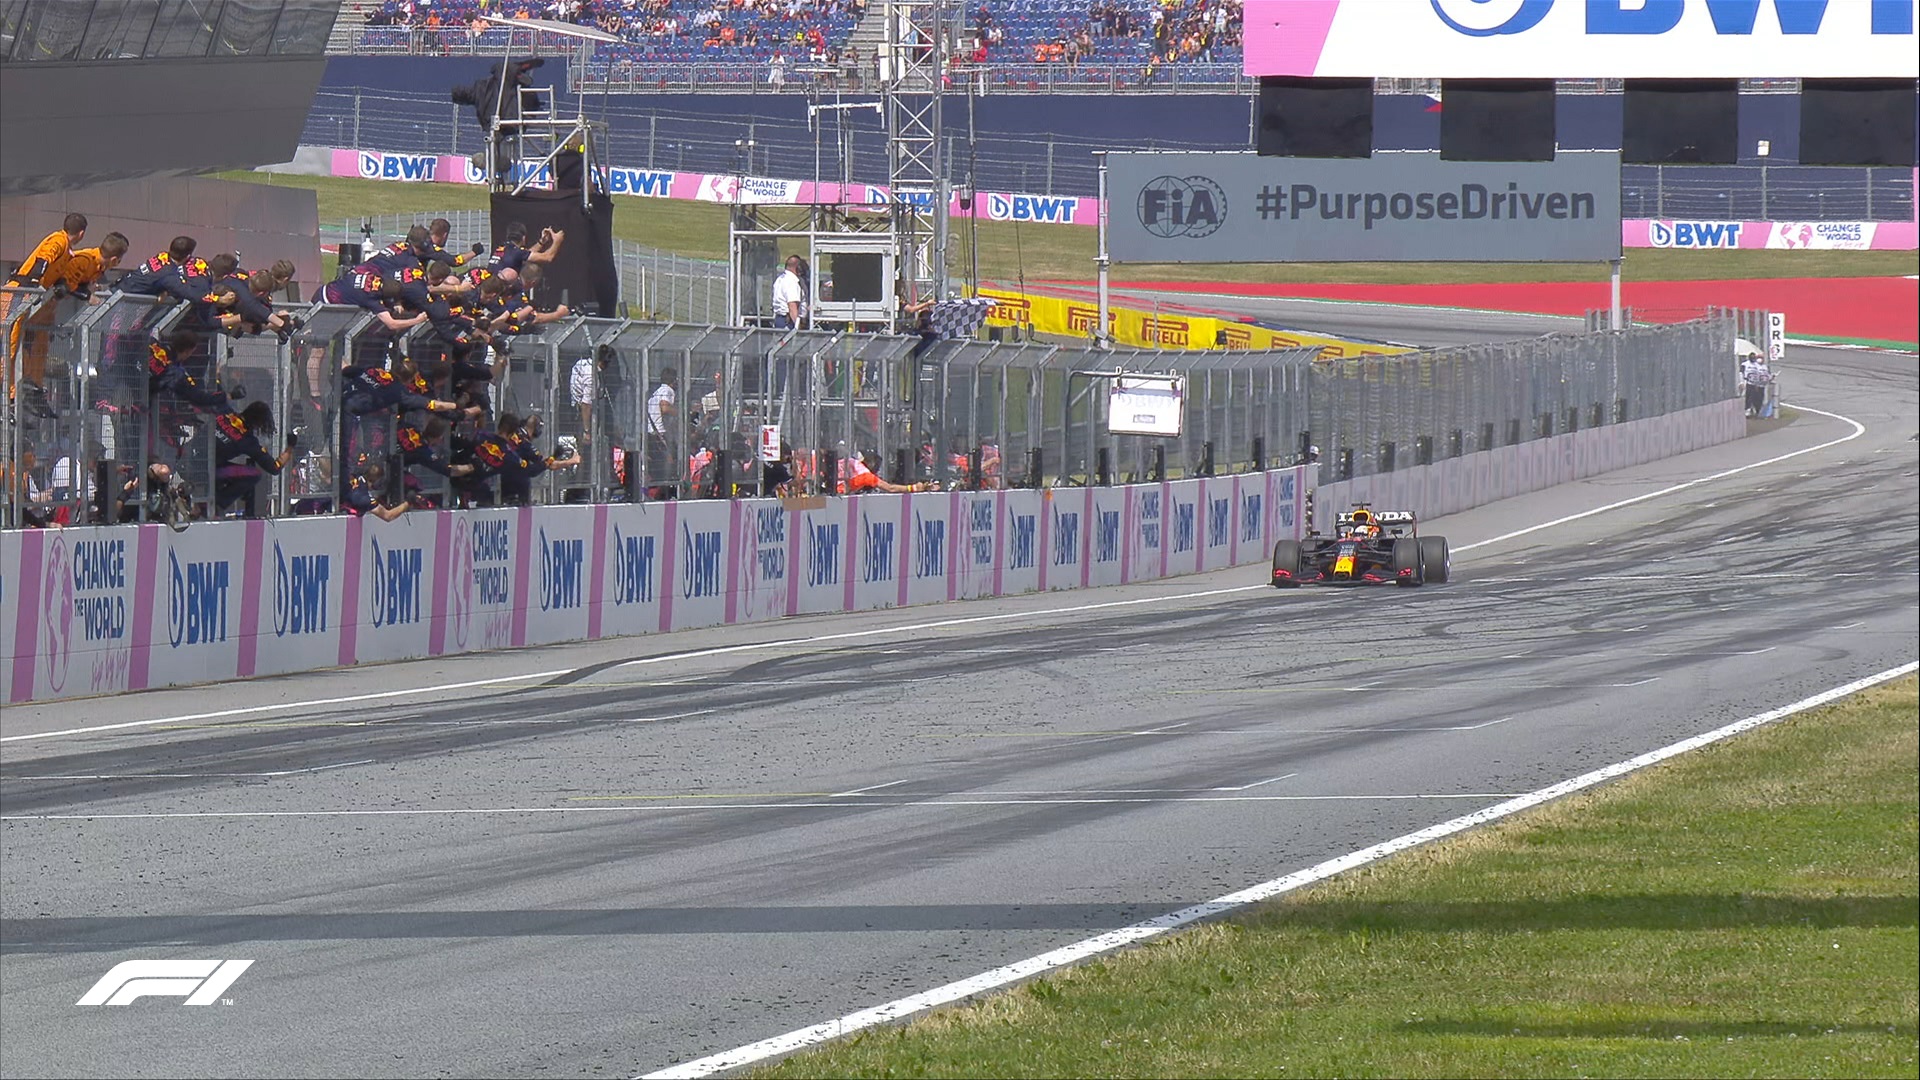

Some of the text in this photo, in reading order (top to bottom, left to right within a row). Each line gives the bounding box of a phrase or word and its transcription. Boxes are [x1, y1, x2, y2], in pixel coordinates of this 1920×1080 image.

[383, 155, 436, 180] BWT
[611, 171, 672, 196] BWT
[745, 178, 787, 190] CHANGE
[753, 187, 786, 197] WORLD
[1013, 197, 1077, 222] BWT
[1256, 182, 1595, 230] #PurposeDriven
[1675, 223, 1740, 246] BWT
[1816, 224, 1861, 233] CHANGE
[757, 507, 784, 542] CHANGE
[1339, 511, 1413, 522] HNDA
[473, 520, 508, 562] CHANGE
[816, 524, 839, 585] BWT
[872, 522, 893, 582] BWT
[924, 520, 944, 577] BWT
[1017, 515, 1036, 568] BWT
[74, 540, 124, 591] CHANGE
[387, 548, 422, 625] BWT
[480, 567, 508, 605] WORLD
[553, 539, 583, 609] BWT
[626, 536, 654, 603] BWT
[694, 532, 721, 597] BWT
[187, 561, 229, 645] BWT
[291, 555, 329, 635] BWT
[85, 596, 124, 641] WORLD
